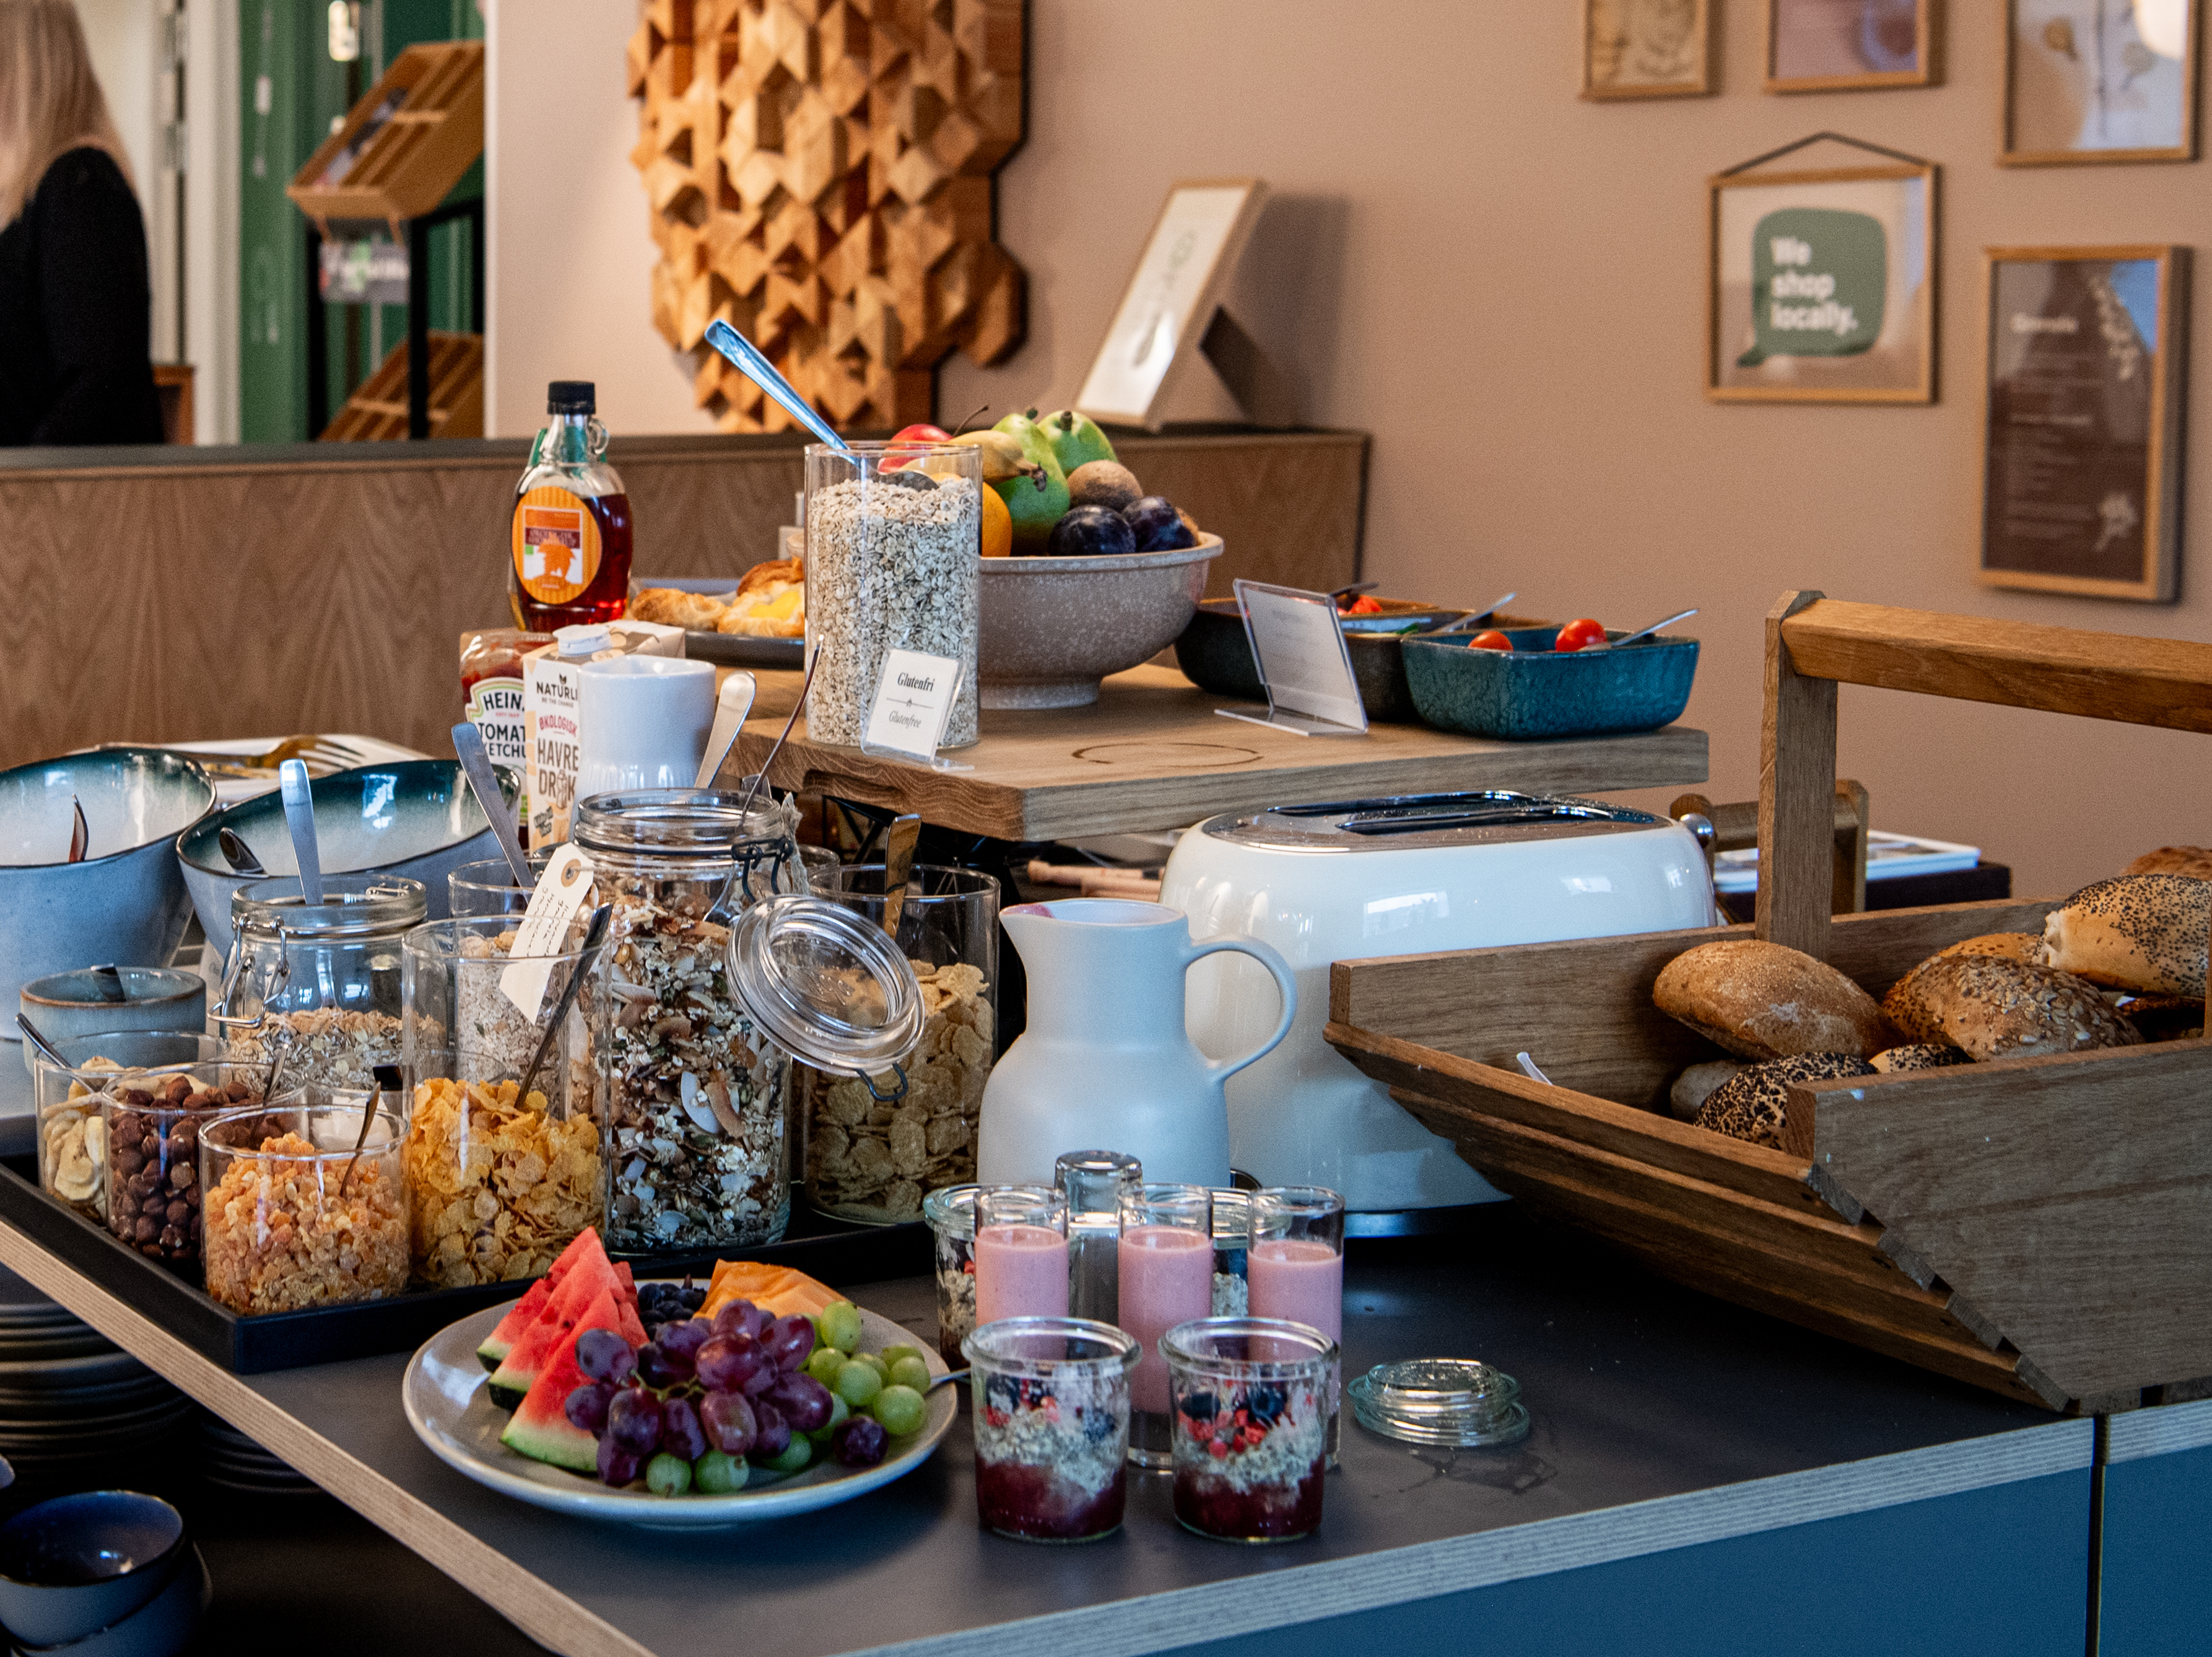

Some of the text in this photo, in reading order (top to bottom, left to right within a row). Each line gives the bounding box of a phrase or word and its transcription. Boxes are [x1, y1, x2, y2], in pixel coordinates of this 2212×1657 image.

[1771, 237, 1811, 266] We
[1772, 271, 1835, 300] shop
[1771, 302, 1858, 335] locally.
[897, 672, 935, 692] Glutenfri
[483, 692, 525, 711] HEIN
[558, 700, 573, 708] CHANGE
[539, 714, 577, 738] ØKOLOGISK
[889, 710, 921, 728] Glutenfree
[478, 722, 525, 742] TOMAT
[484, 742, 526, 758] ETCHU
[538, 738, 578, 771] HAVRE
